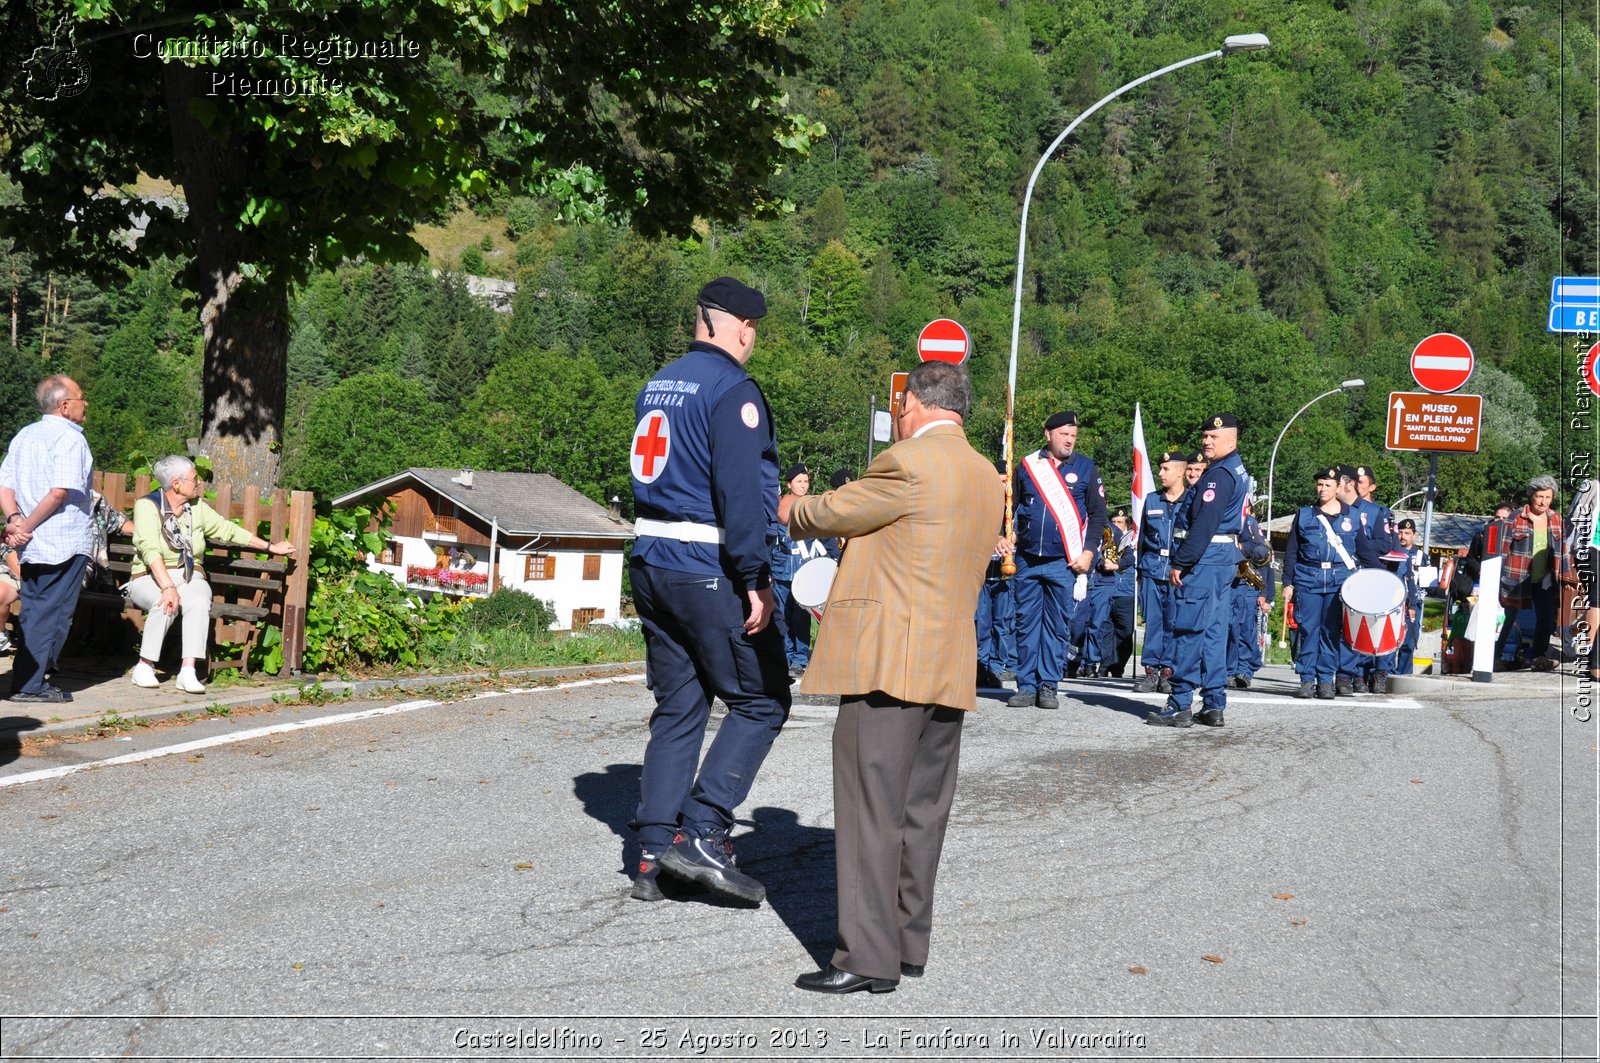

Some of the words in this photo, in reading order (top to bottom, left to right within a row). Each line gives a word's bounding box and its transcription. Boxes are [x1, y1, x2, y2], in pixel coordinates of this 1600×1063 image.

[643, 393, 685, 407] FANFARA
[1421, 403, 1458, 413] MUSEO
[1405, 414, 1419, 422] EN
[1423, 414, 1452, 424] PLEIN
[1456, 416, 1474, 425] AIR
[1409, 433, 1466, 442] CASTELDELFINO
